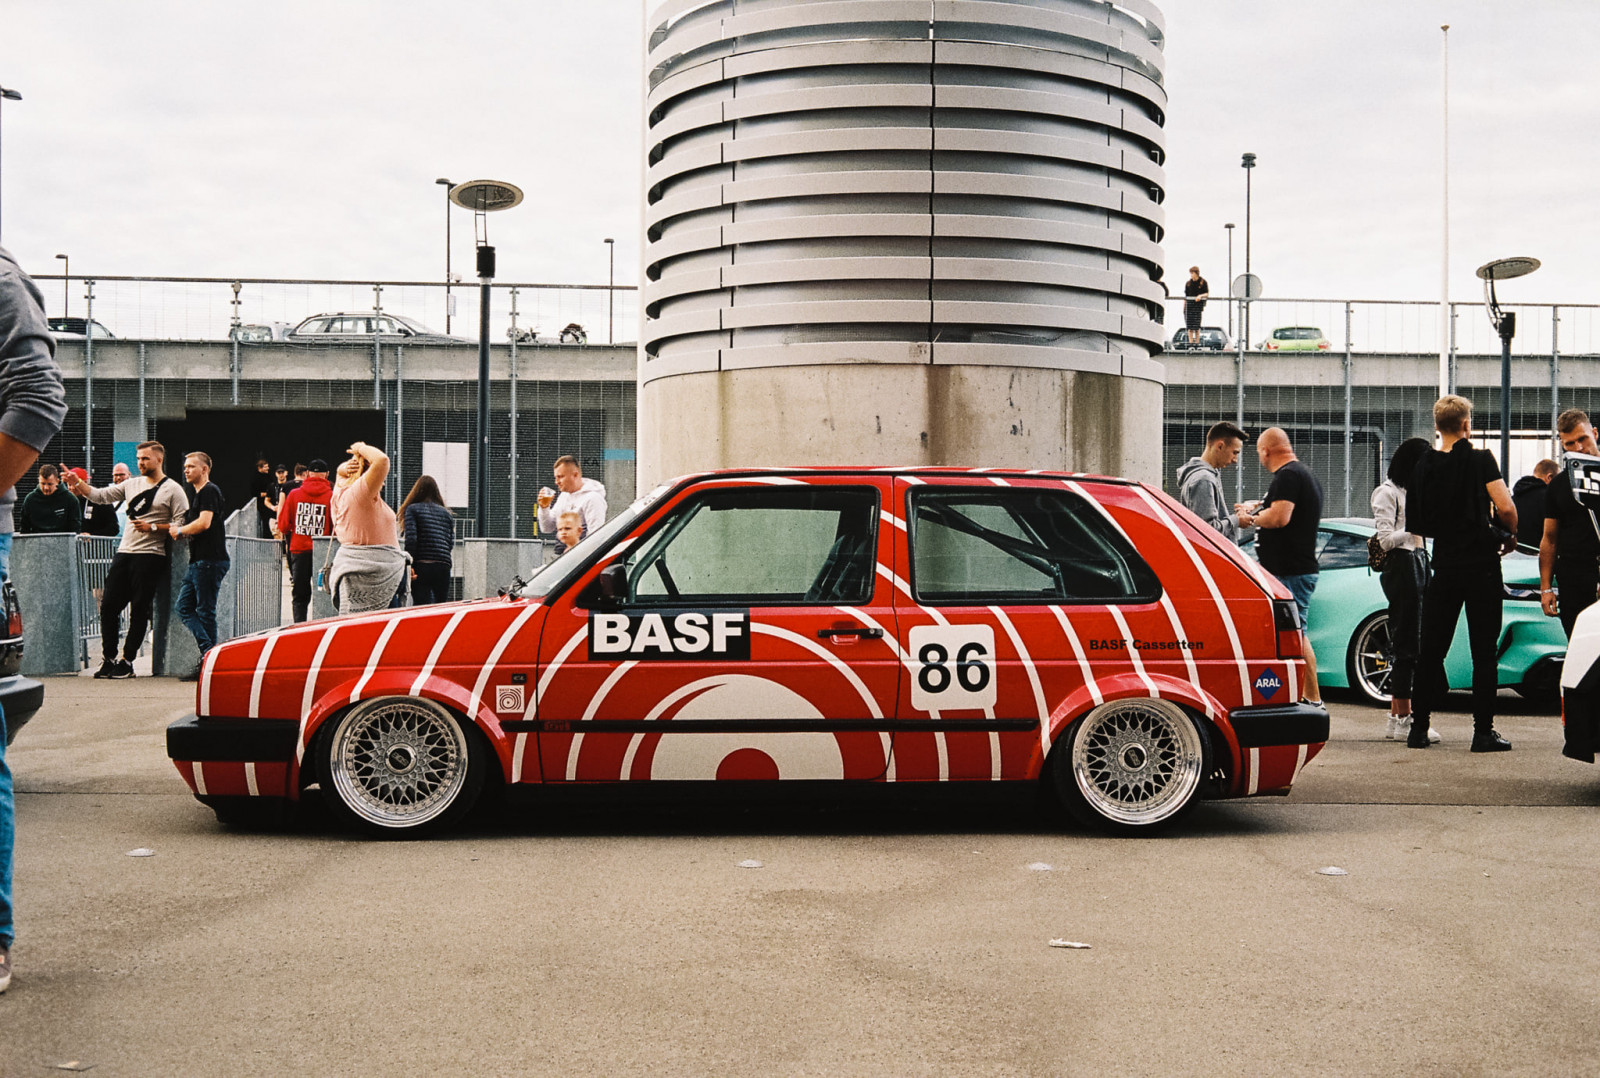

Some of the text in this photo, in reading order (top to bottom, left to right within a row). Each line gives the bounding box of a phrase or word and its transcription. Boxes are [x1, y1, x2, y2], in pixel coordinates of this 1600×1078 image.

[297, 502, 326, 516] DRIFT
[295, 513, 325, 528] TEAM
[295, 526, 324, 536] REVILO
[593, 613, 745, 653] BASF
[1089, 639, 1204, 650] BASF Cassetten
[918, 642, 990, 694] 86
[1255, 677, 1281, 688] ARAL
